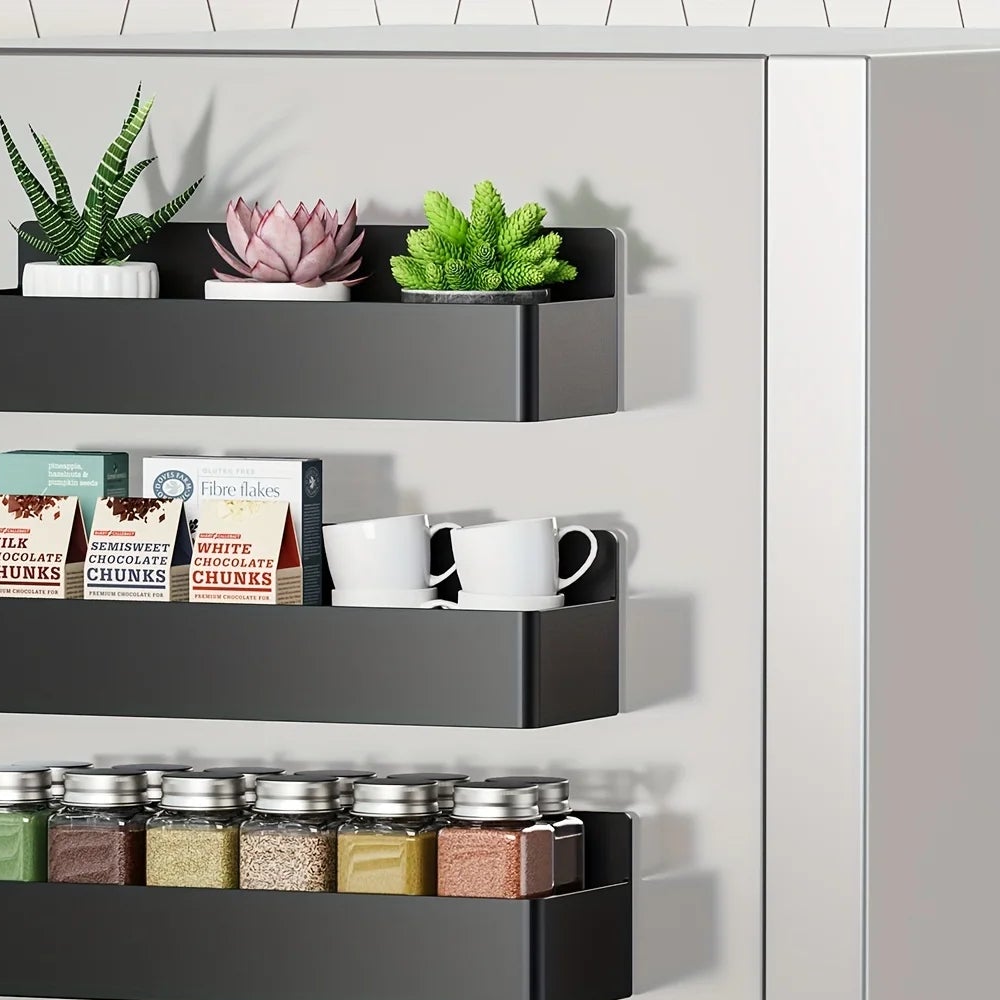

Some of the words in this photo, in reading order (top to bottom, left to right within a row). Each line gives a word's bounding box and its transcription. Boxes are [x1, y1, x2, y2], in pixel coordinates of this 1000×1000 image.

[201, 481, 236, 497] Fibre
[240, 481, 280, 498] flakes
[90, 541, 170, 553] SEMISWEET
[197, 542, 252, 555] WHITE
[88, 555, 168, 565] CHOCOLATE
[194, 557, 274, 569] CHOCOLATE
[87, 567, 166, 583] CHUNKS
[192, 570, 272, 586] CHUNKS
